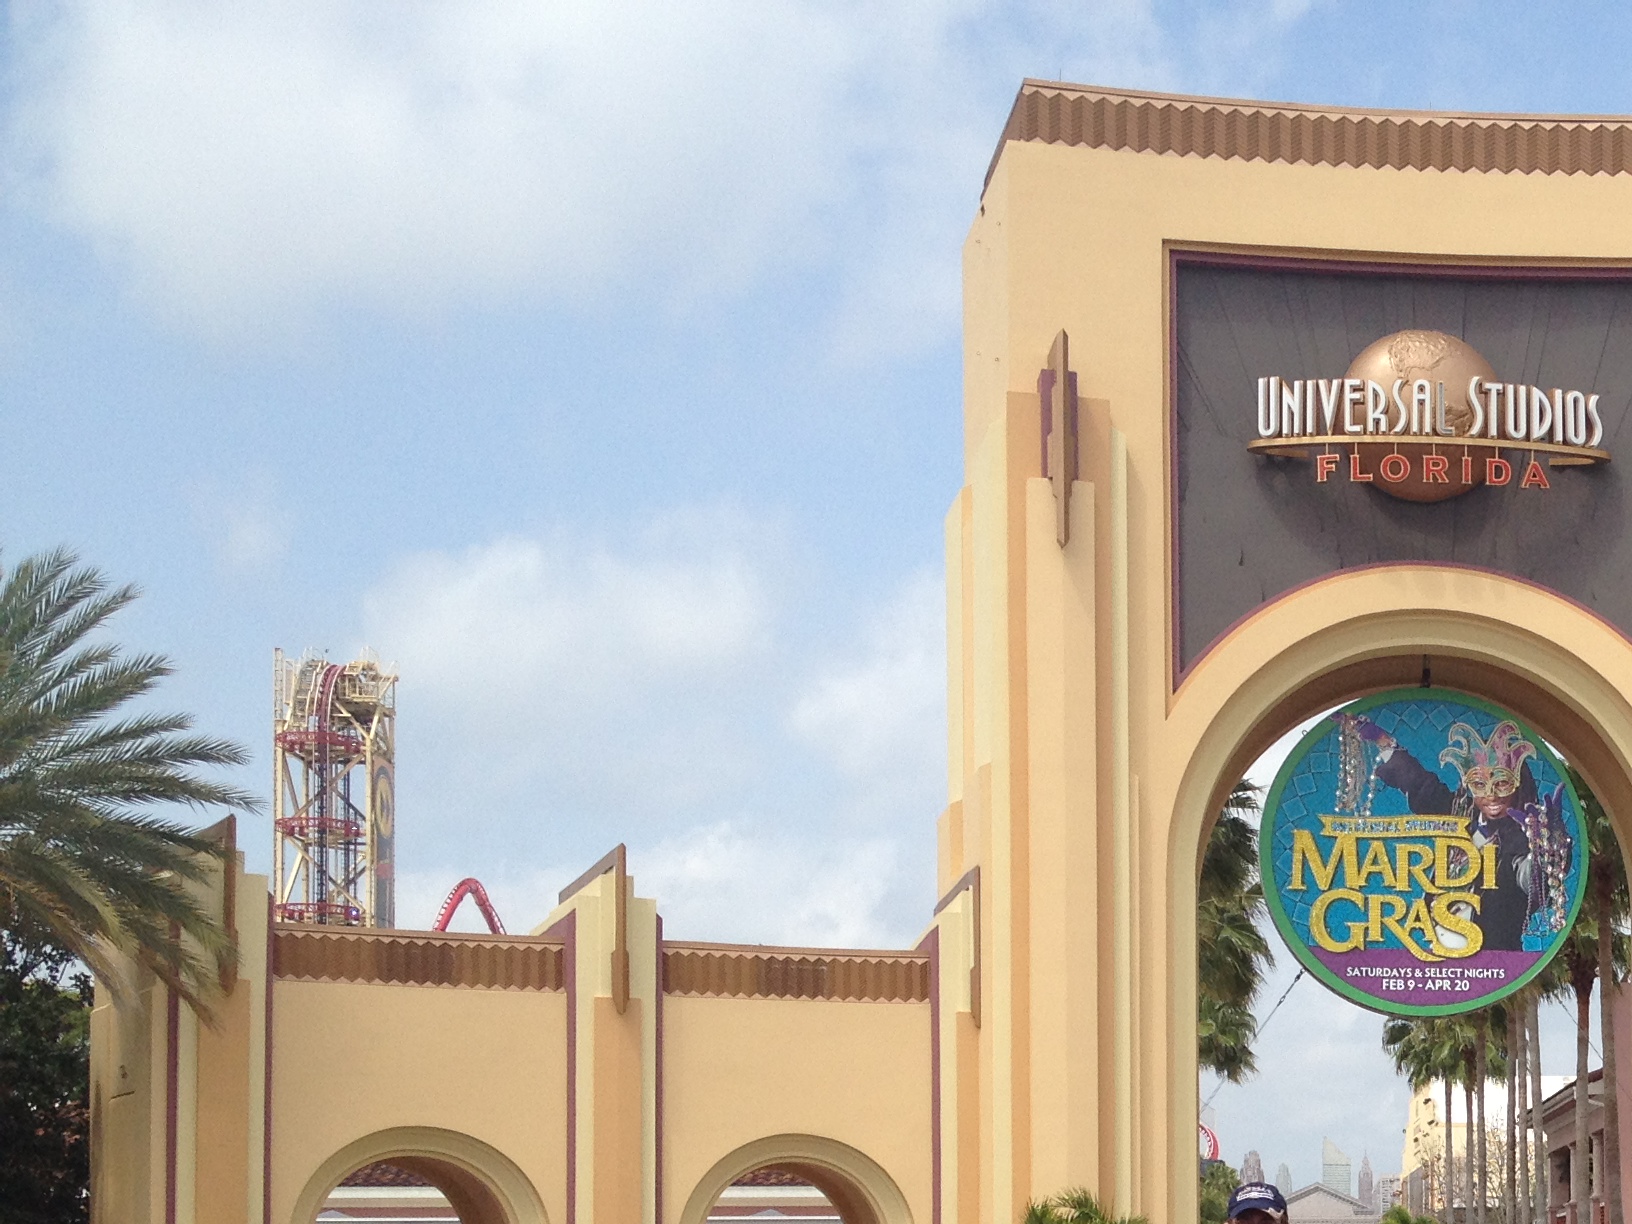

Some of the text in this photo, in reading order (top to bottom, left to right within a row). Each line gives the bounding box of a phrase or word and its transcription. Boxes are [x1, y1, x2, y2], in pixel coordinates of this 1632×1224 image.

[1257, 376, 1602, 448] UNIVERSAL STUDIOS
[1316, 453, 1550, 489] FLORIDA
[1287, 829, 1499, 894] MARDI
[1308, 887, 1484, 962] GRAS
[1346, 967, 1505, 979] SATURDAYS & SELECT NIGHTS
[1382, 979, 1404, 991] FEB
[1407, 979, 1416, 991] 9
[1425, 979, 1451, 991] APR
[1454, 979, 1470, 991] 20
